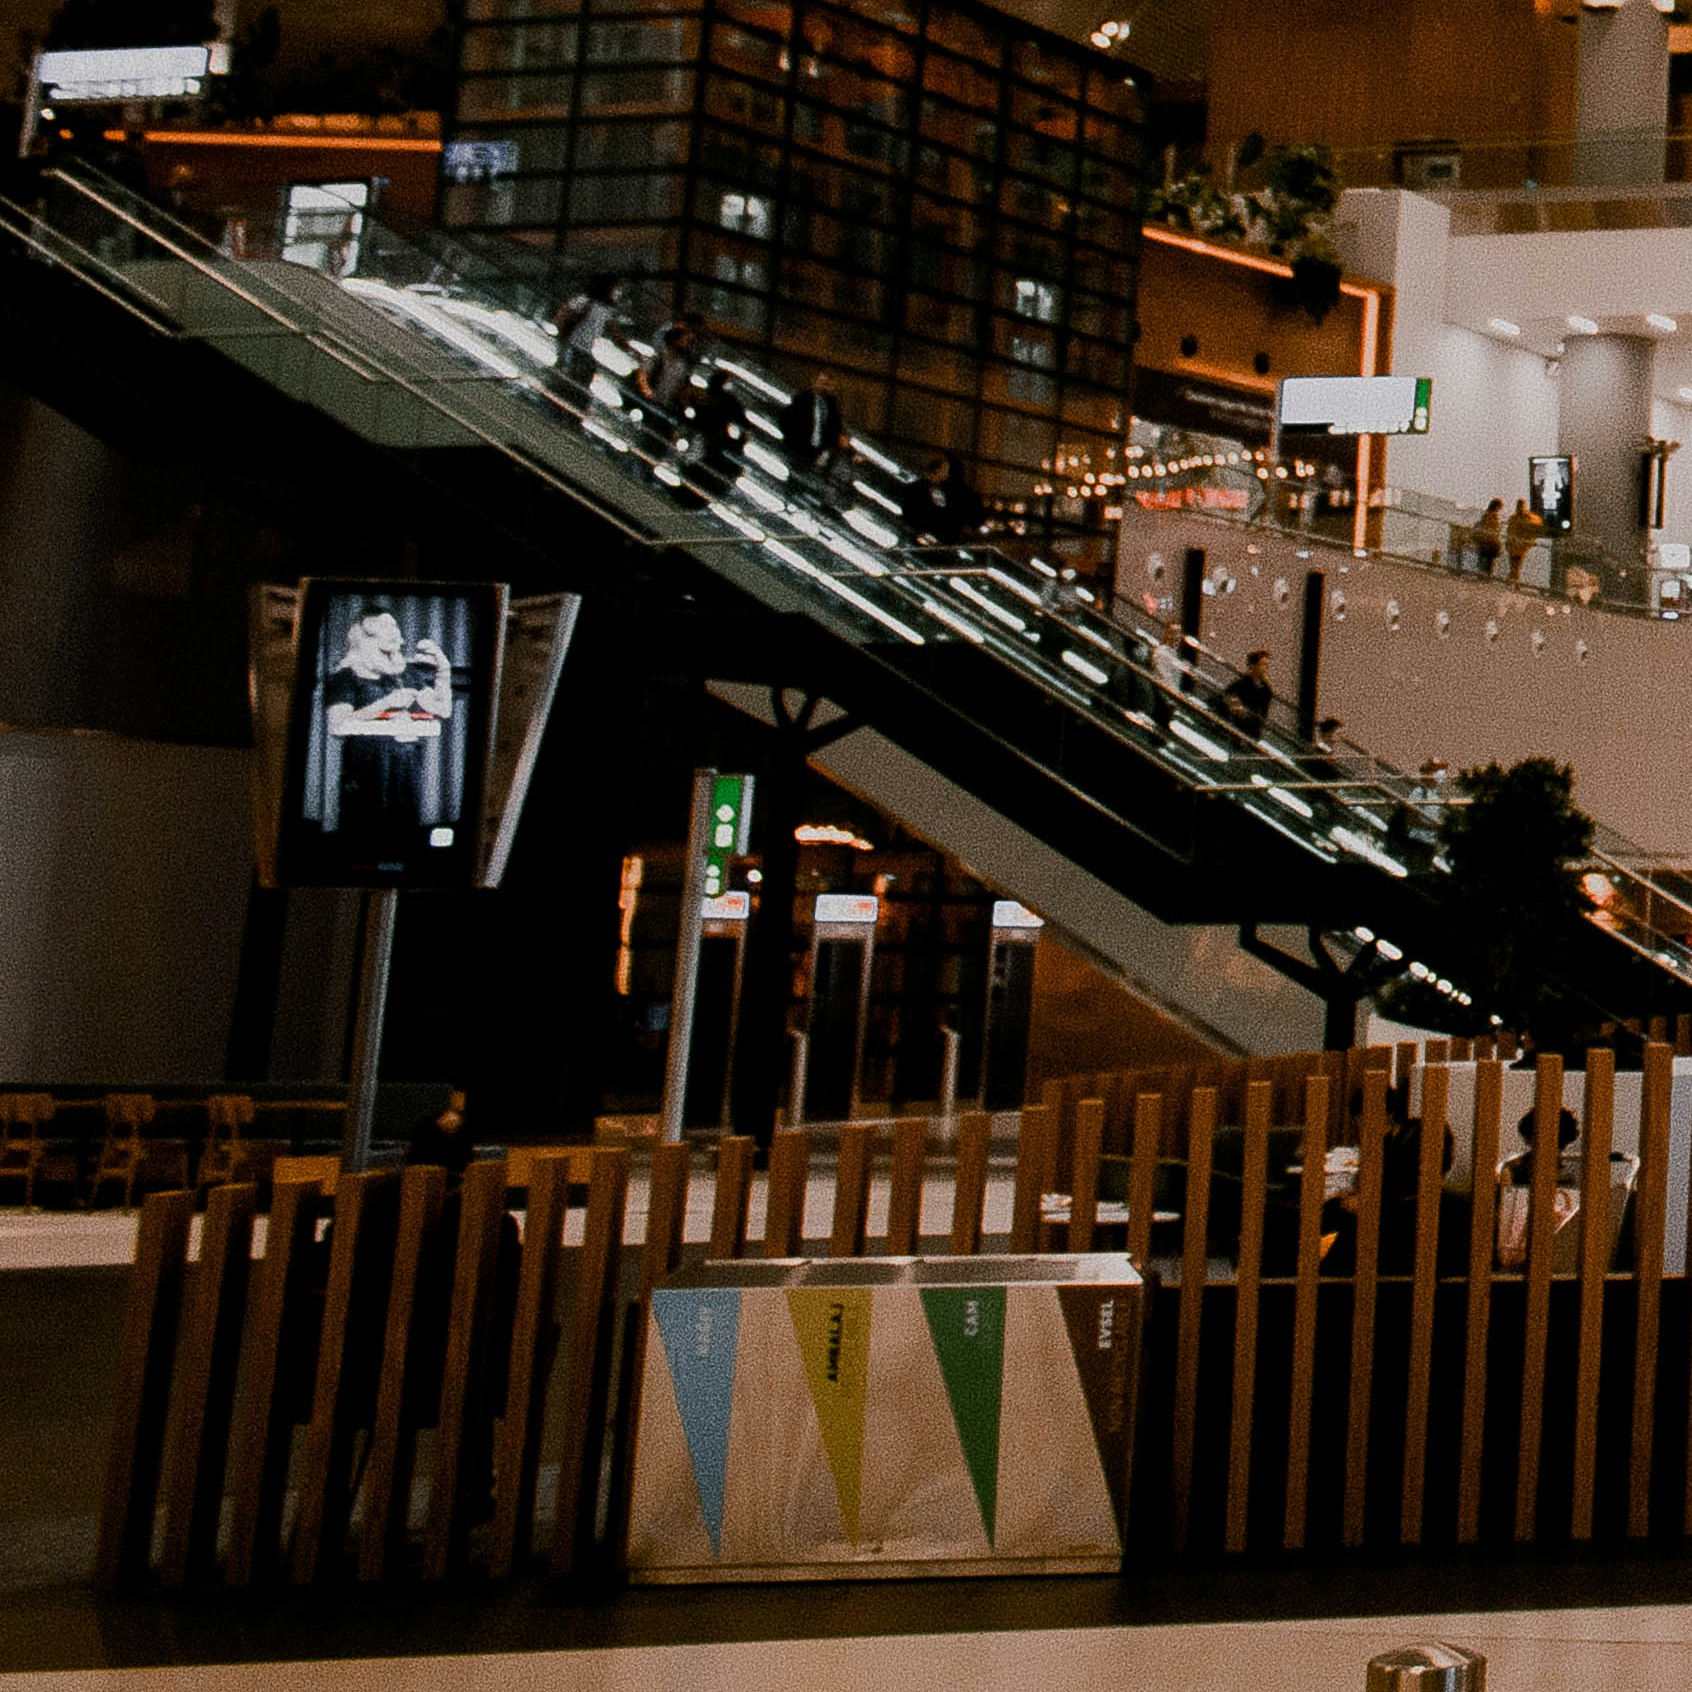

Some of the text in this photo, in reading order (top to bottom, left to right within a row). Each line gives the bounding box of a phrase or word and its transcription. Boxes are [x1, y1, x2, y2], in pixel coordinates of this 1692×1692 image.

[827, 1303, 844, 1383] AMBALAJ
[964, 1299, 981, 1337] CAM
[1099, 1299, 1115, 1349] EVSEL
